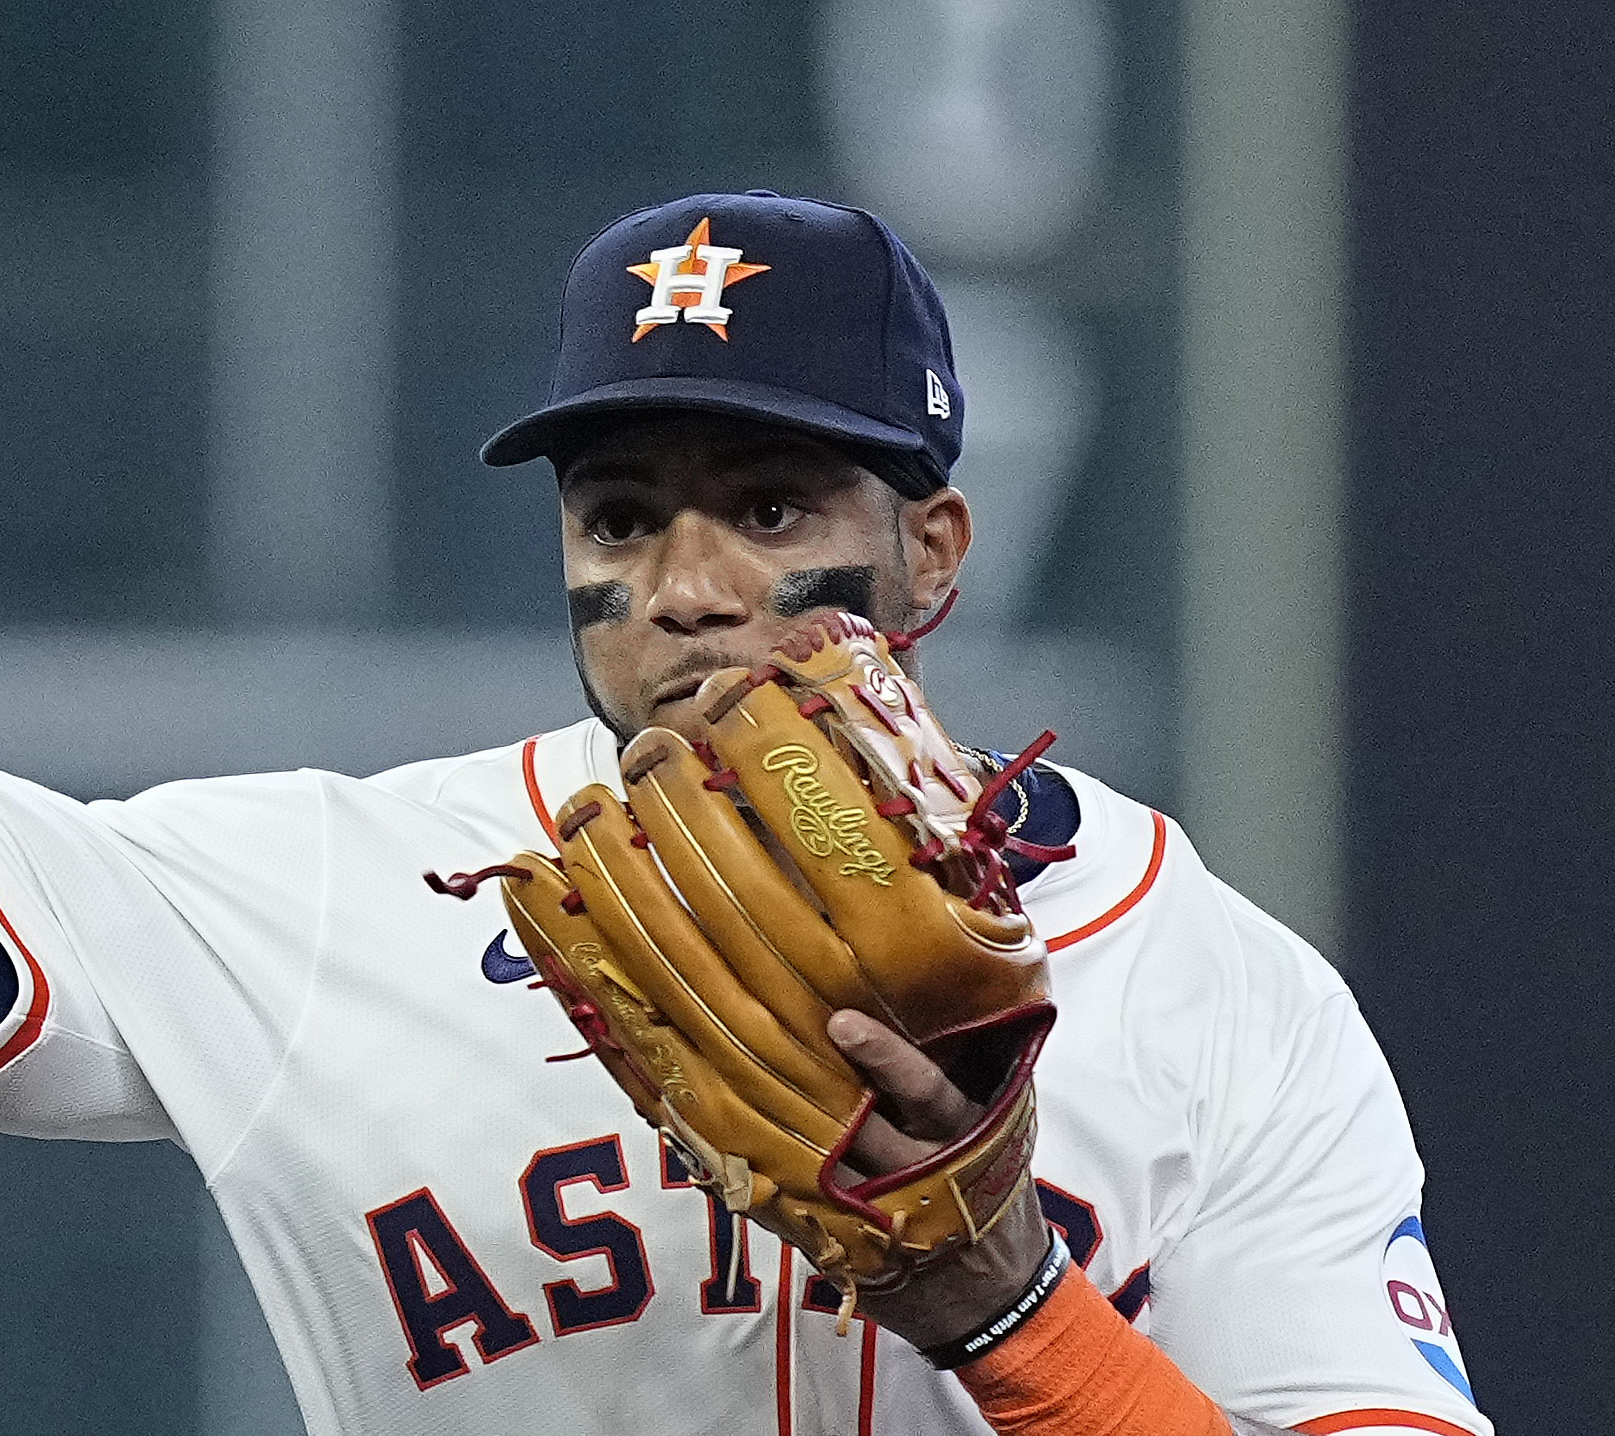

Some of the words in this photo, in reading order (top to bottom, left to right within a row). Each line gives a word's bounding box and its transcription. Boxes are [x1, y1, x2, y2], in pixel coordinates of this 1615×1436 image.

[636, 243, 744, 326] H
[762, 743, 896, 887] Rawlings
[1018, 1290, 1038, 1312] Am
[965, 1333, 993, 1352] You
